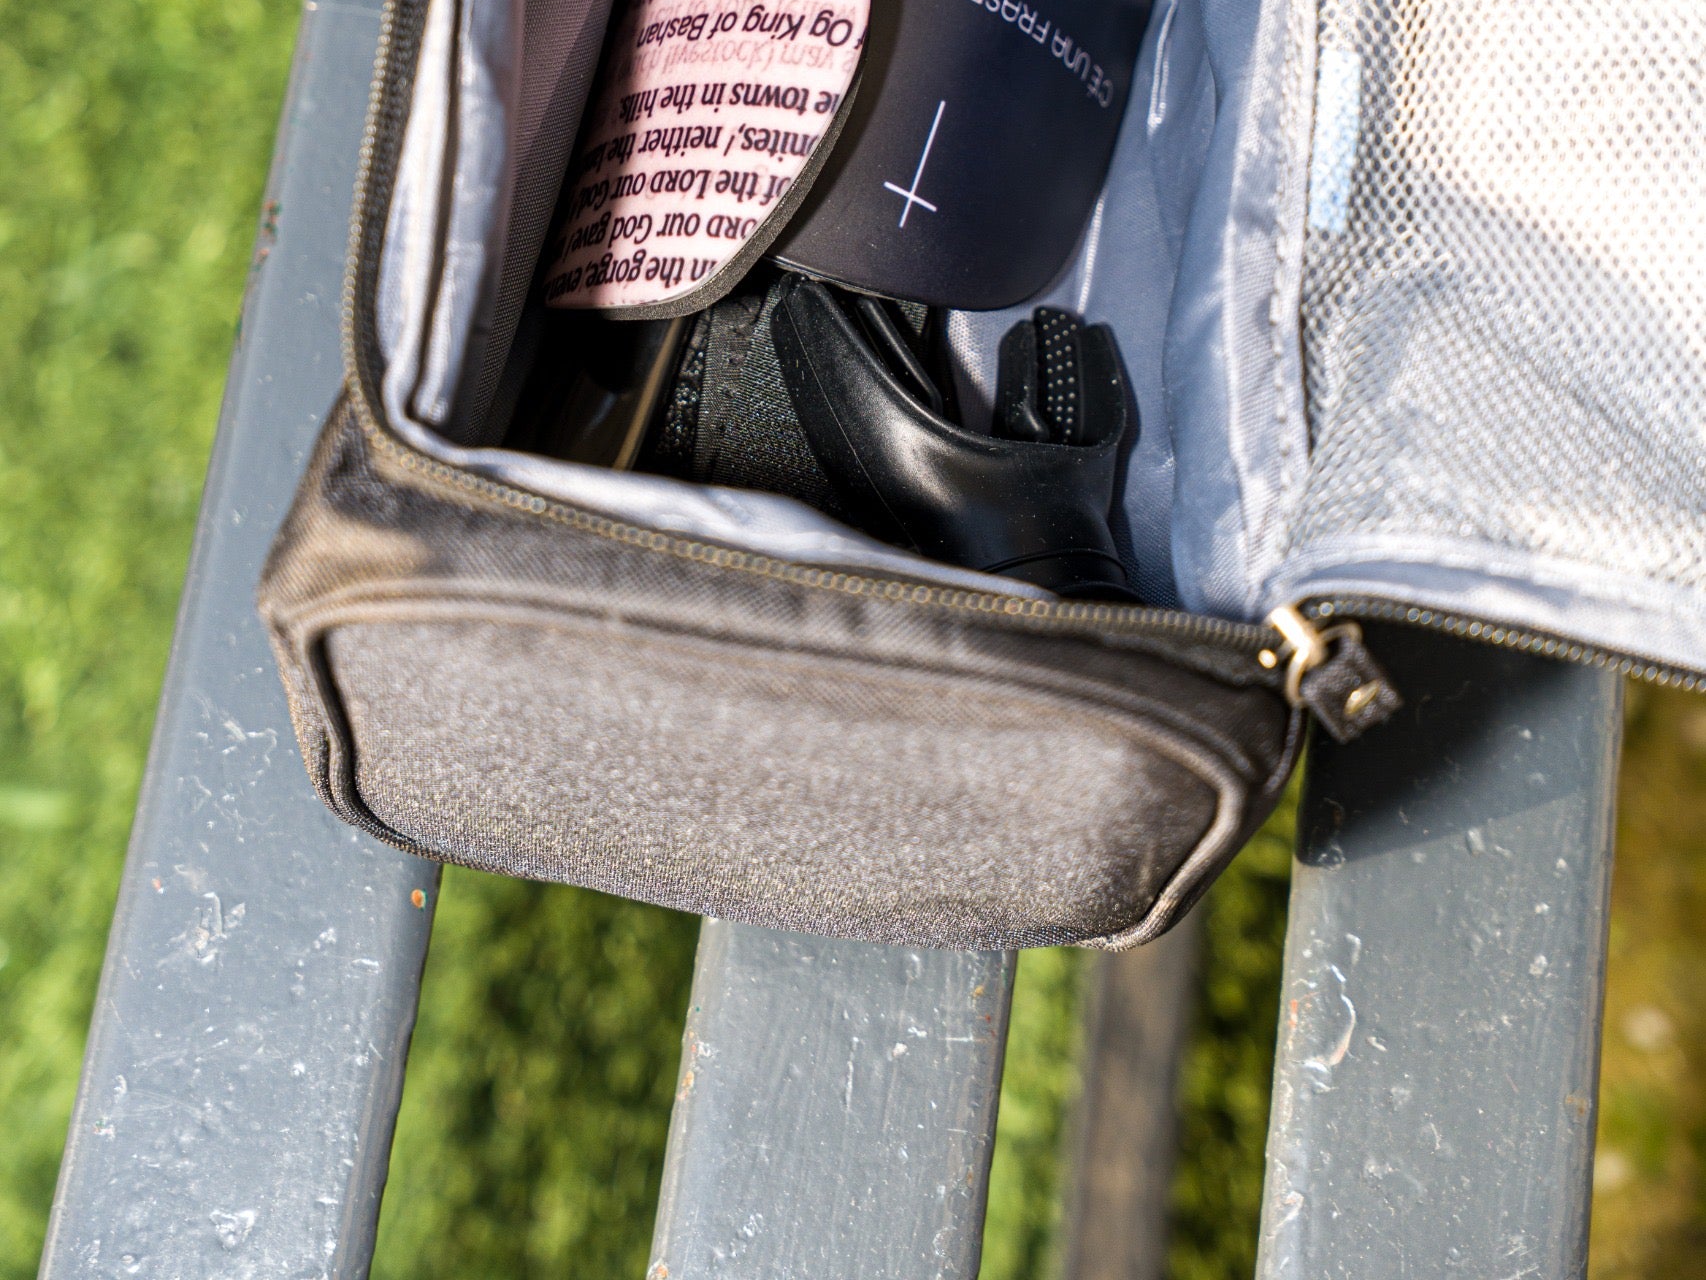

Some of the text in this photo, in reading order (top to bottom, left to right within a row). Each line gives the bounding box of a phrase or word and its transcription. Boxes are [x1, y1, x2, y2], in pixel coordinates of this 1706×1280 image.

[636, 13, 708, 48] Bashan
[707, 12, 737, 38] of
[742, 5, 805, 41] King
[810, 10, 853, 47] Og
[1051, 28, 1091, 81] UNA
[661, 85, 696, 114] the
[701, 84, 722, 112] in
[728, 83, 809, 116] towns
[609, 134, 636, 165] the
[639, 126, 722, 158] neither
[610, 173, 645, 197] our
[715, 171, 758, 204] the
[607, 214, 652, 247] God
[656, 213, 700, 239] our
[585, 250, 645, 288] gorge,
[642, 258, 684, 288] the
